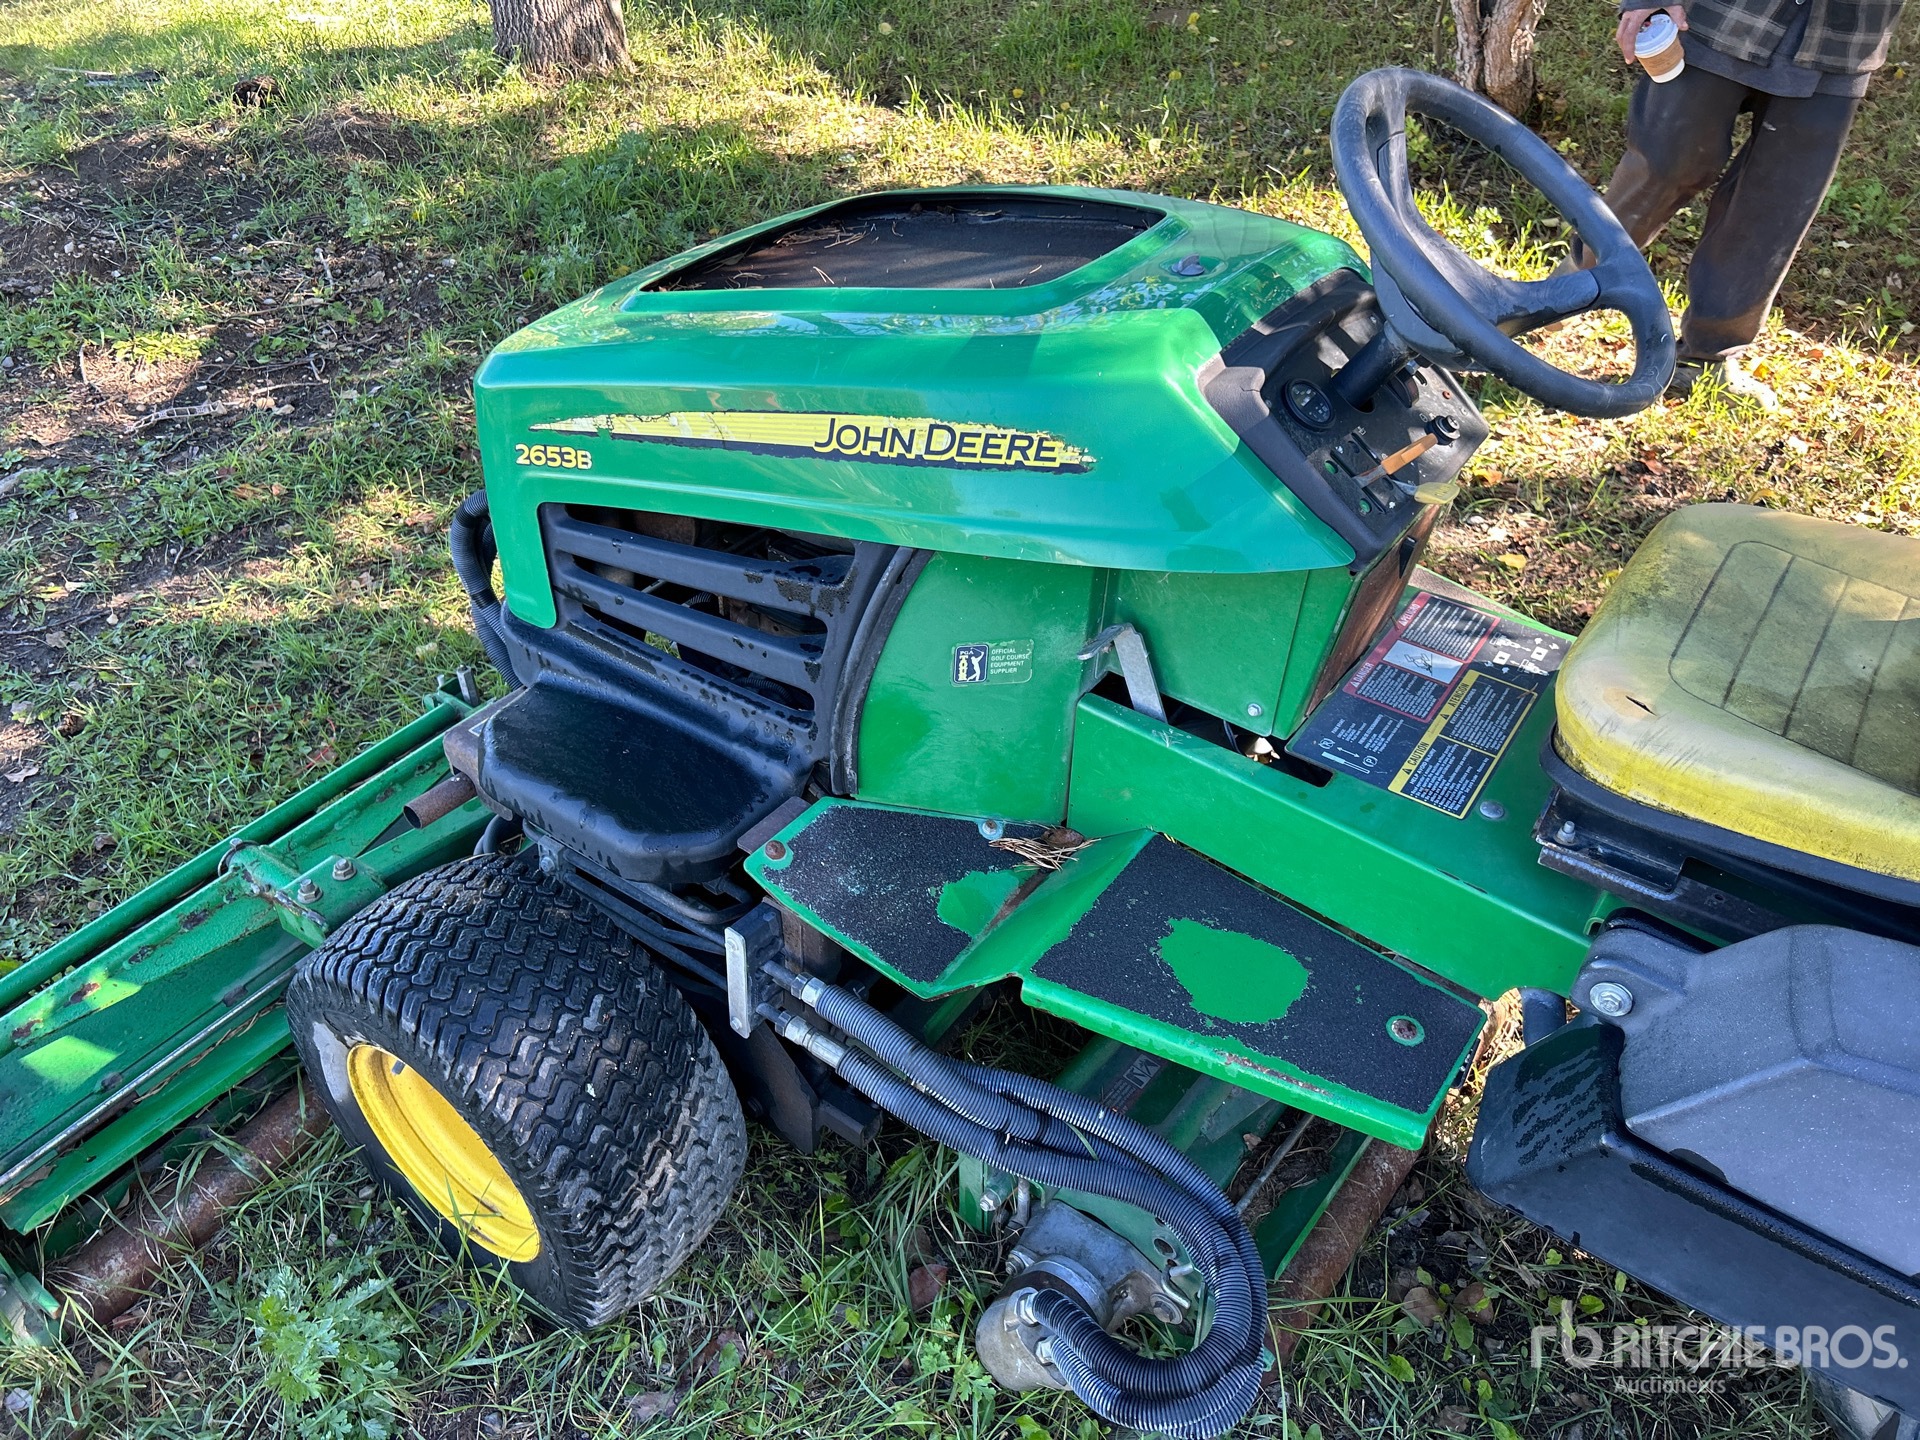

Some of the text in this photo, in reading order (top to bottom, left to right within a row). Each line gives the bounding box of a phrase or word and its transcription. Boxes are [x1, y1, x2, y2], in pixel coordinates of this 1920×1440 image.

[814, 417, 1058, 463] JOHN DEERE
[515, 443, 592, 469] 2653B
[990, 660, 1024, 668] EQUIPMENT
[990, 667, 1017, 675] SUPPLIER
[1351, 661, 1375, 682] DANGER
[1406, 741, 1430, 765] CAUTION
